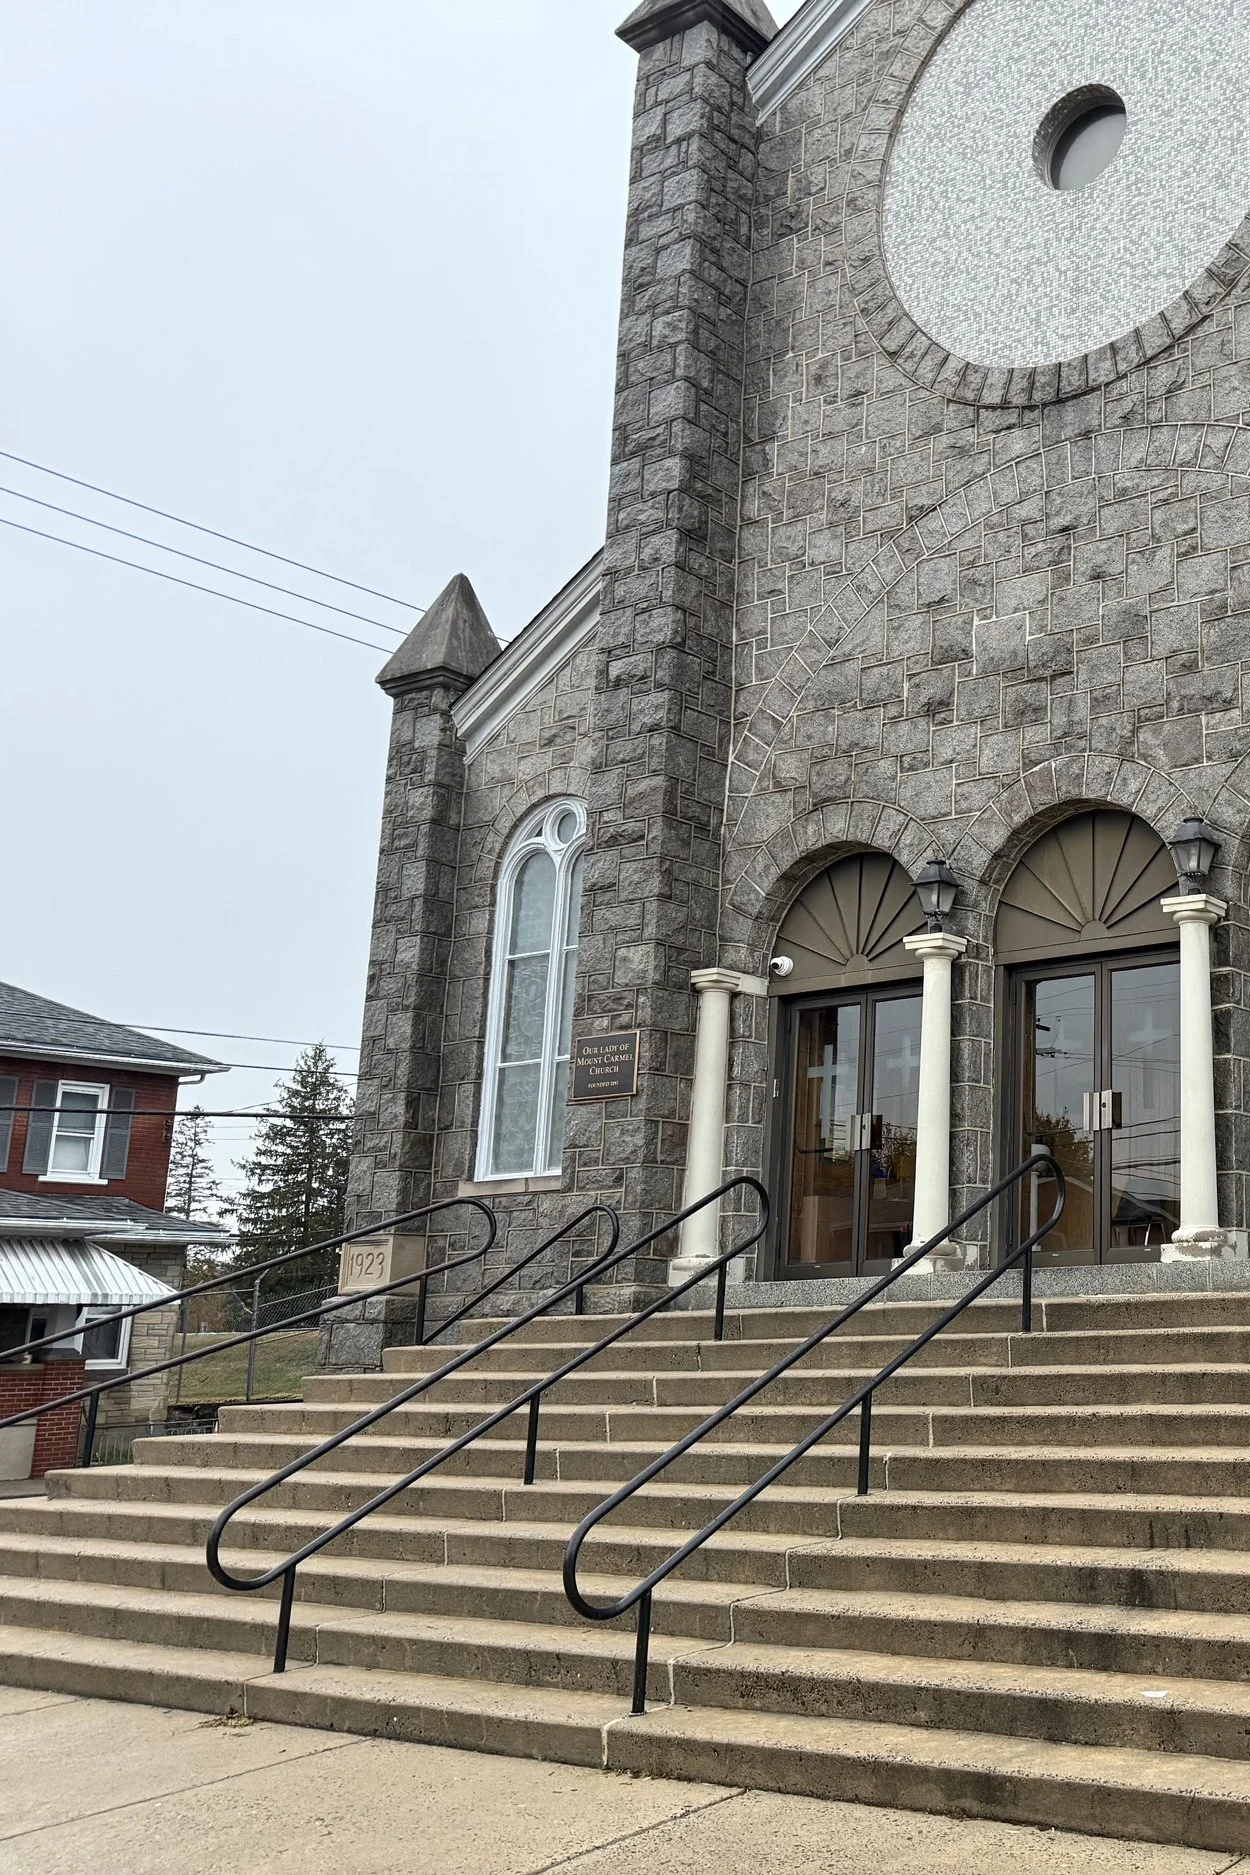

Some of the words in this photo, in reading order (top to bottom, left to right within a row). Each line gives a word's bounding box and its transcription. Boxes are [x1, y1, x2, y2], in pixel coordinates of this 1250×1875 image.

[582, 1046, 598, 1055] OUR
[600, 1045, 618, 1053] LADY
[620, 1043, 630, 1051] OF
[576, 1056, 603, 1066] MOUNT
[604, 1054, 633, 1064] CARMEL
[590, 1065, 619, 1075] CHURCH
[350, 1252, 386, 1279] 1923
